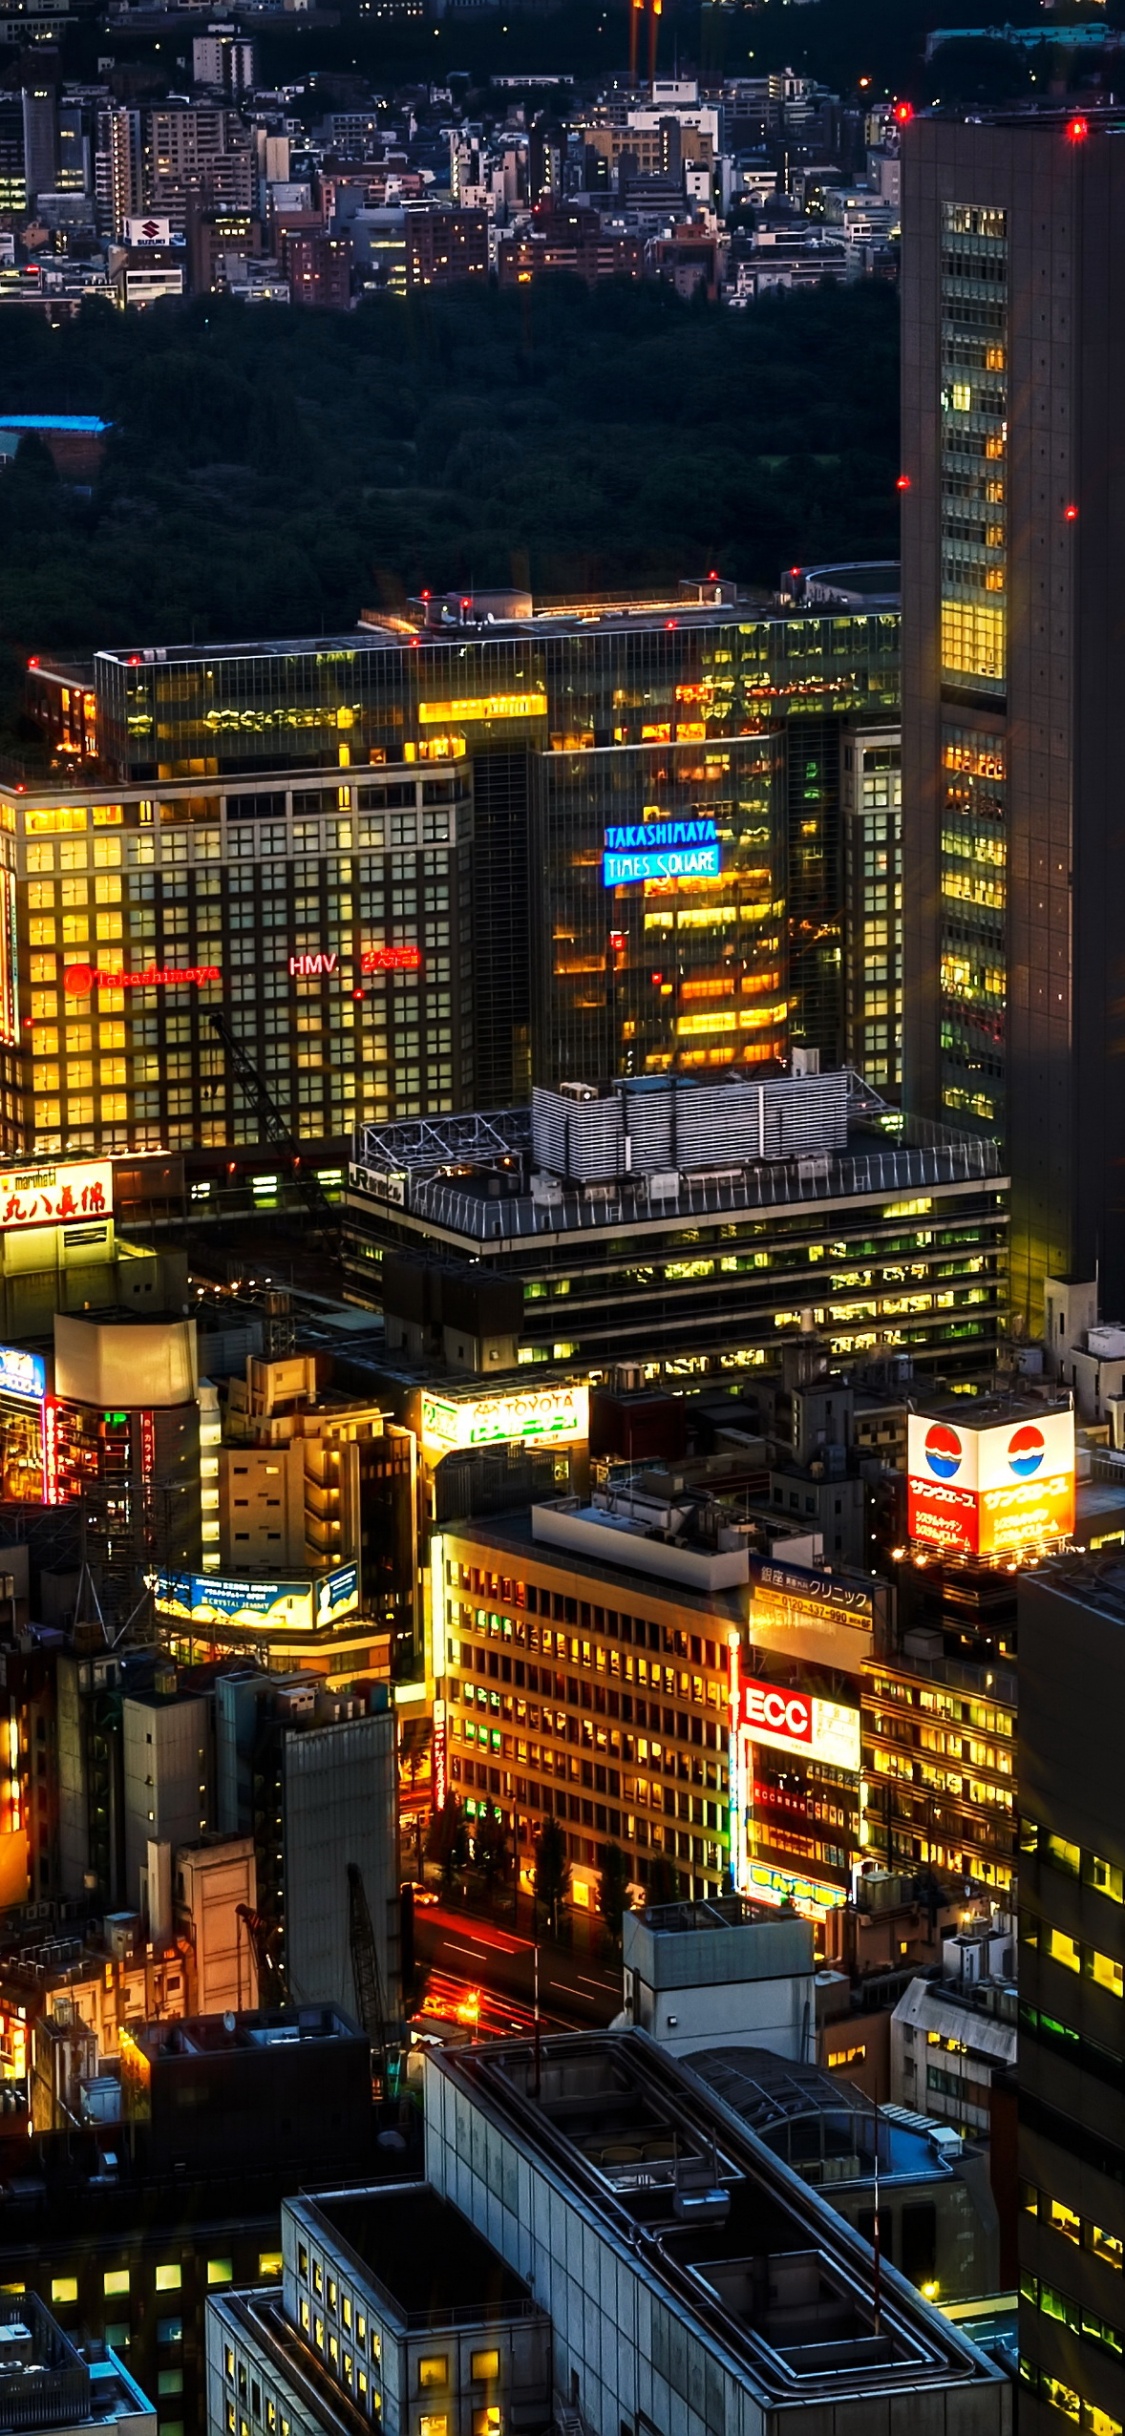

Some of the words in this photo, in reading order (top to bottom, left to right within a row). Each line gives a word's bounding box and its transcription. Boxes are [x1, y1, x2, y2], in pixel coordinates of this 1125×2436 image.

[606, 820, 716, 849] TAKASHIMAYA
[608, 856, 641, 878] TIMES
[656, 851, 716, 886] SQUARE
[94, 963, 220, 988] Takashimaya
[289, 953, 336, 976] HMV
[503, 1392, 575, 1417] TOYOTA
[761, 1566, 784, 1587] 銀座
[809, 1580, 867, 1608] クリニック
[208, 1597, 239, 1608] CRYSTAL
[781, 1595, 848, 1623] 0120-437-990
[745, 1686, 808, 1734] ECC
